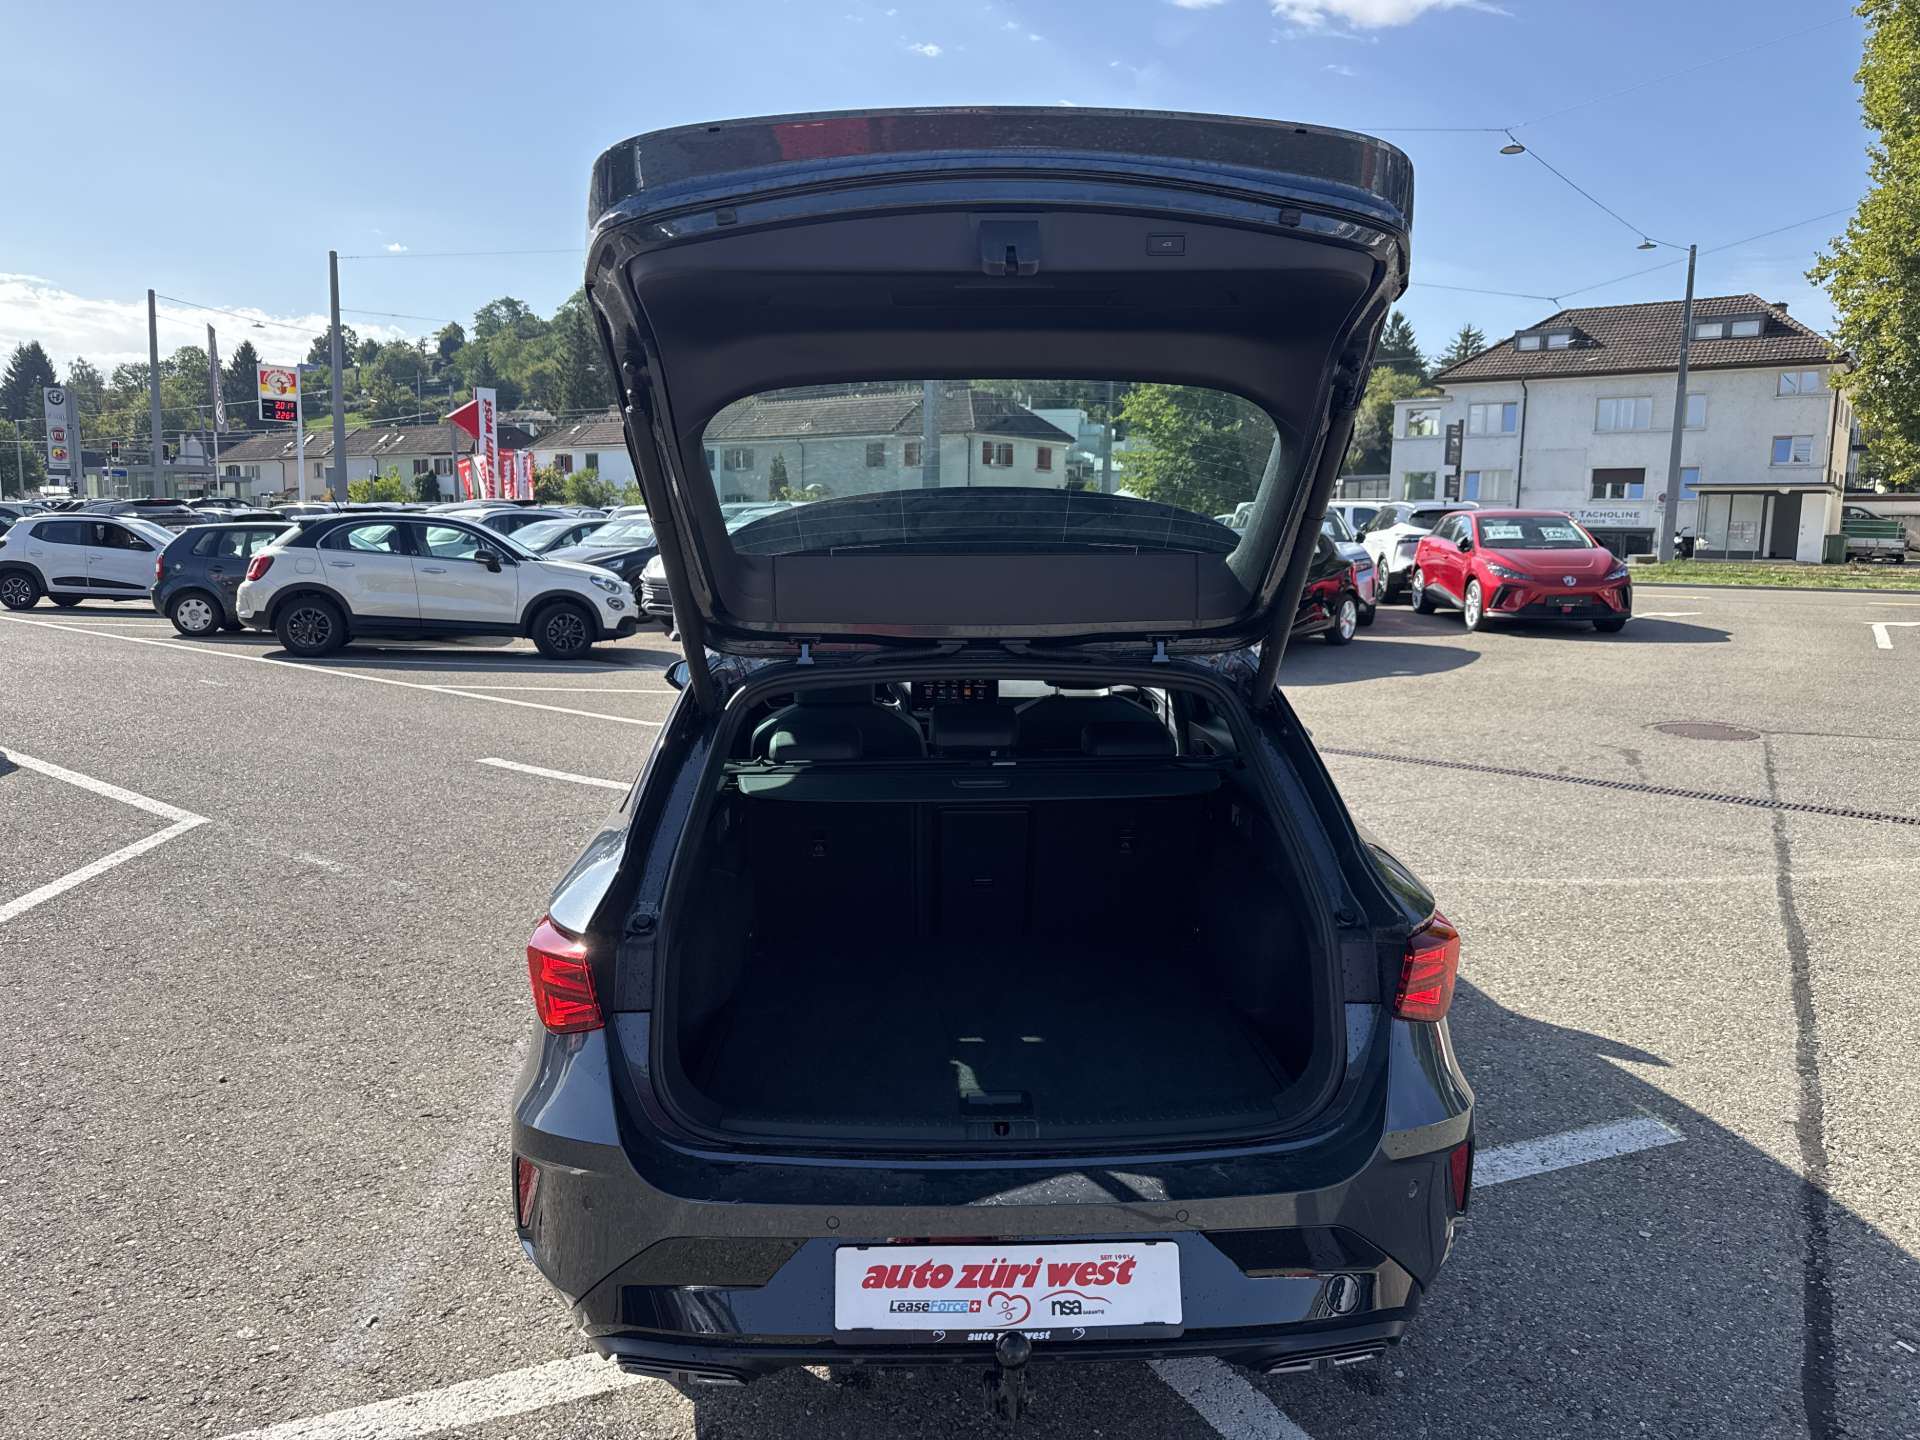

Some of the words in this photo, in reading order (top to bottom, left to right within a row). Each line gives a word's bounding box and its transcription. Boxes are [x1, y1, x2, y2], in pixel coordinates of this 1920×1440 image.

[861, 1258, 954, 1289] auto
[954, 1257, 1043, 1289] züri
[1047, 1256, 1137, 1287] west
[889, 1299, 969, 1313] LeaseForce
[1051, 1300, 1082, 1316] nsa
[967, 1332, 995, 1341] auto
